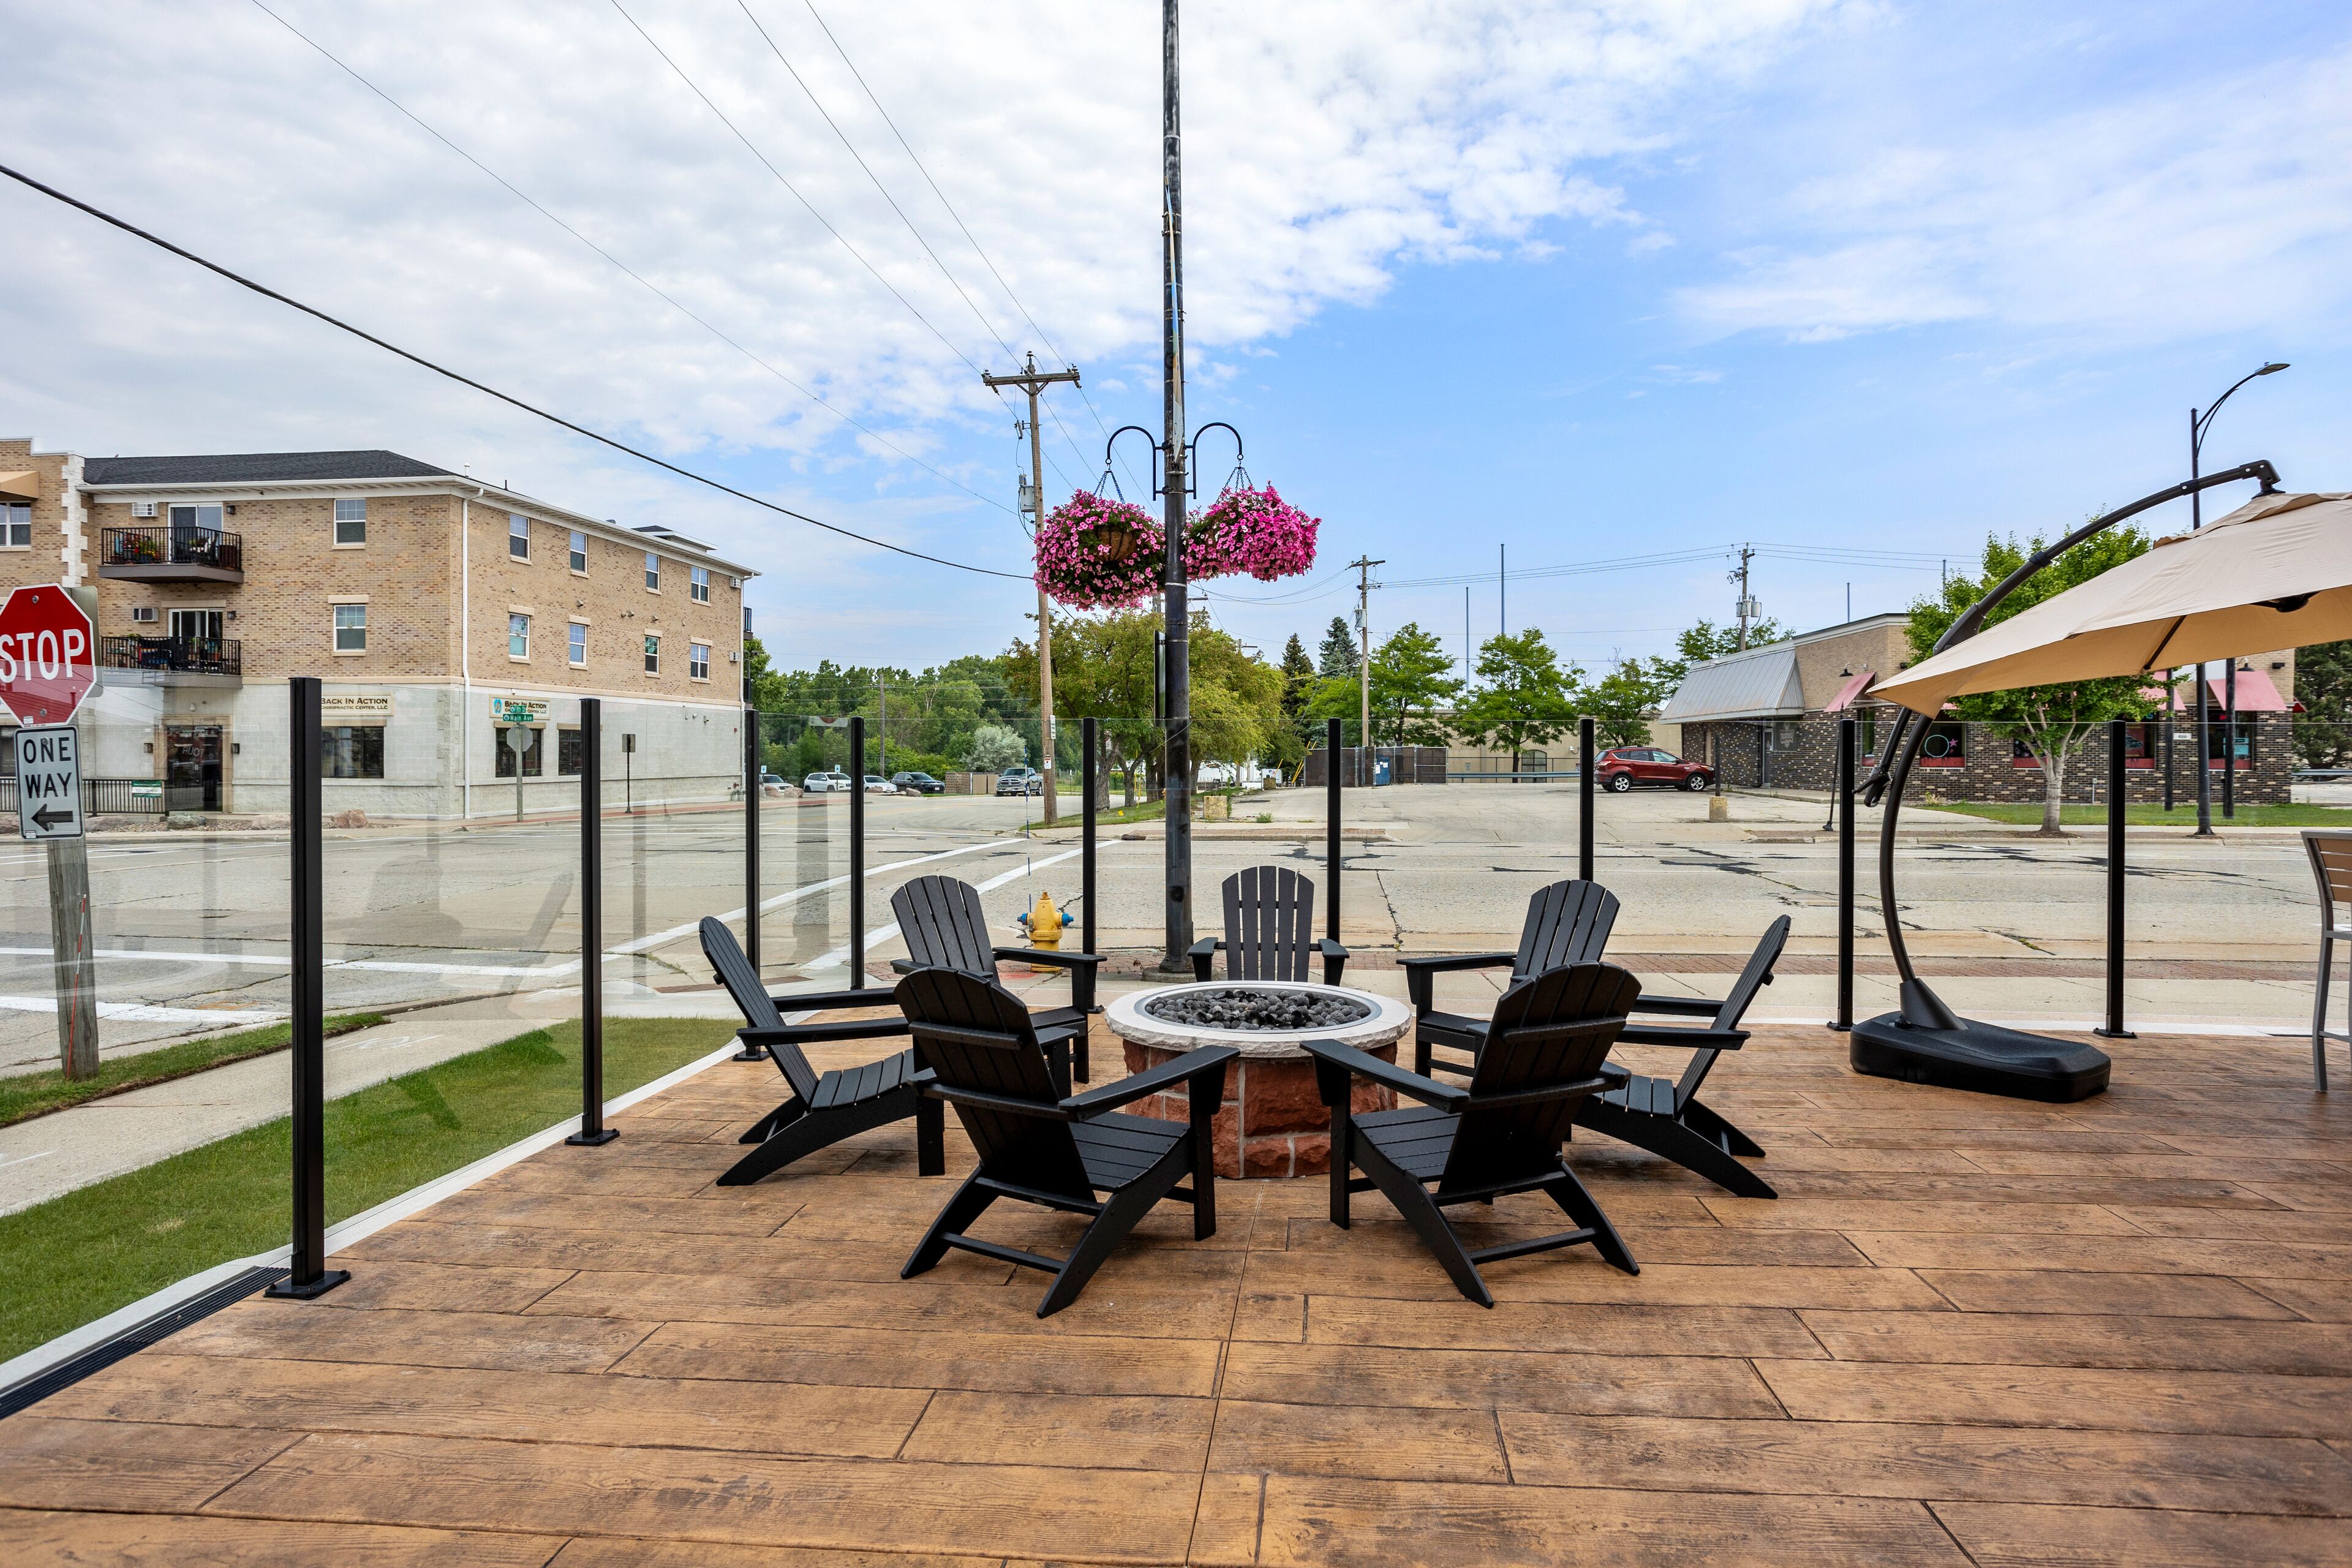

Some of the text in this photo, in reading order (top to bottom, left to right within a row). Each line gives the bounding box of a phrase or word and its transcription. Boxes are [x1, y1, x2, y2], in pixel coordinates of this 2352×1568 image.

[0, 628, 85, 683] STOP
[23, 736, 72, 764] ONE
[24, 772, 72, 799] WAY
